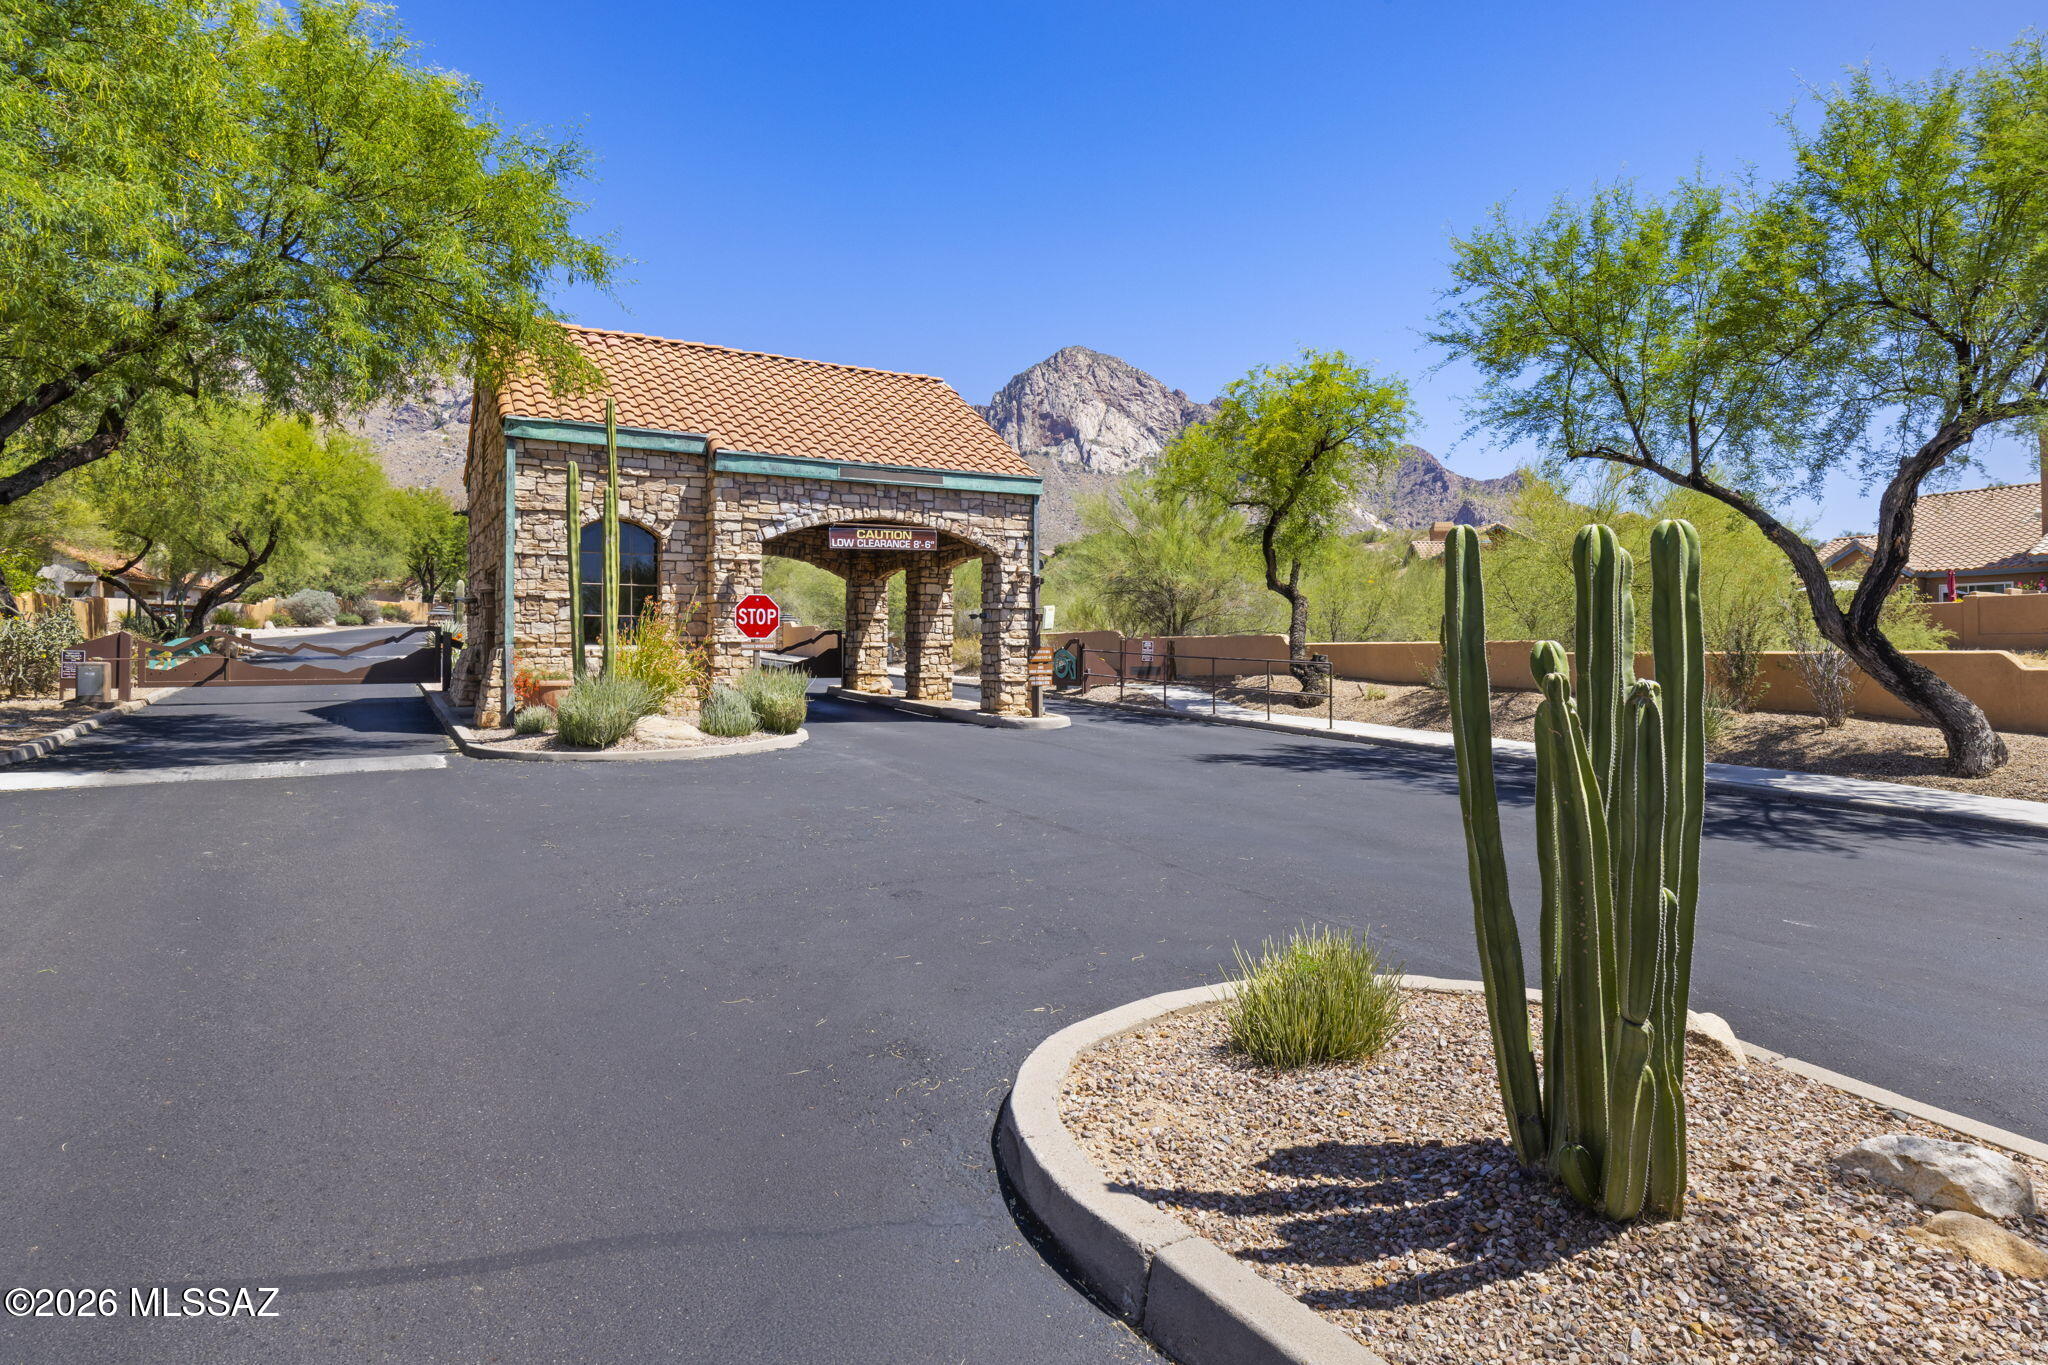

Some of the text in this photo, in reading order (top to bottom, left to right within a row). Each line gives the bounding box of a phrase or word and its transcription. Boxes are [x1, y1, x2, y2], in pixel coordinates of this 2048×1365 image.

[856, 529, 912, 540] CAUTION
[831, 538, 854, 547] LOW
[857, 539, 911, 548] CLEARANCE
[738, 608, 777, 625] STOP
